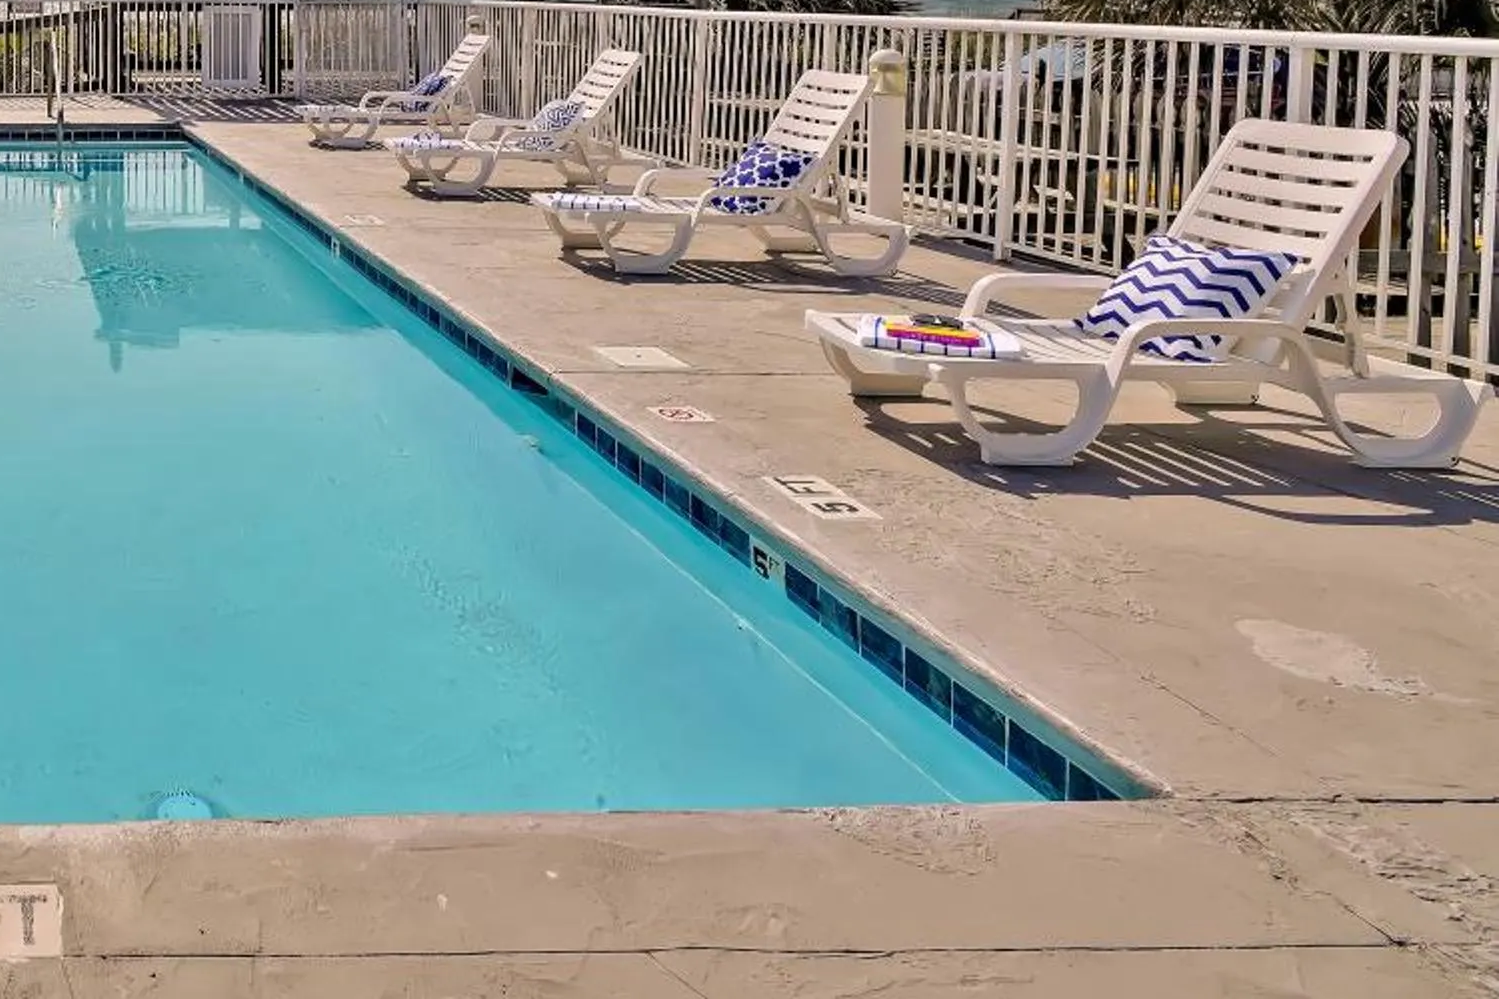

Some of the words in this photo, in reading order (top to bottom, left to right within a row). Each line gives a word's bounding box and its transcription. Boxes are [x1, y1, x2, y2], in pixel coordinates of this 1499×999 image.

[773, 476, 832, 494] FT
[812, 502, 859, 514] 5
[753, 546, 770, 580] 5
